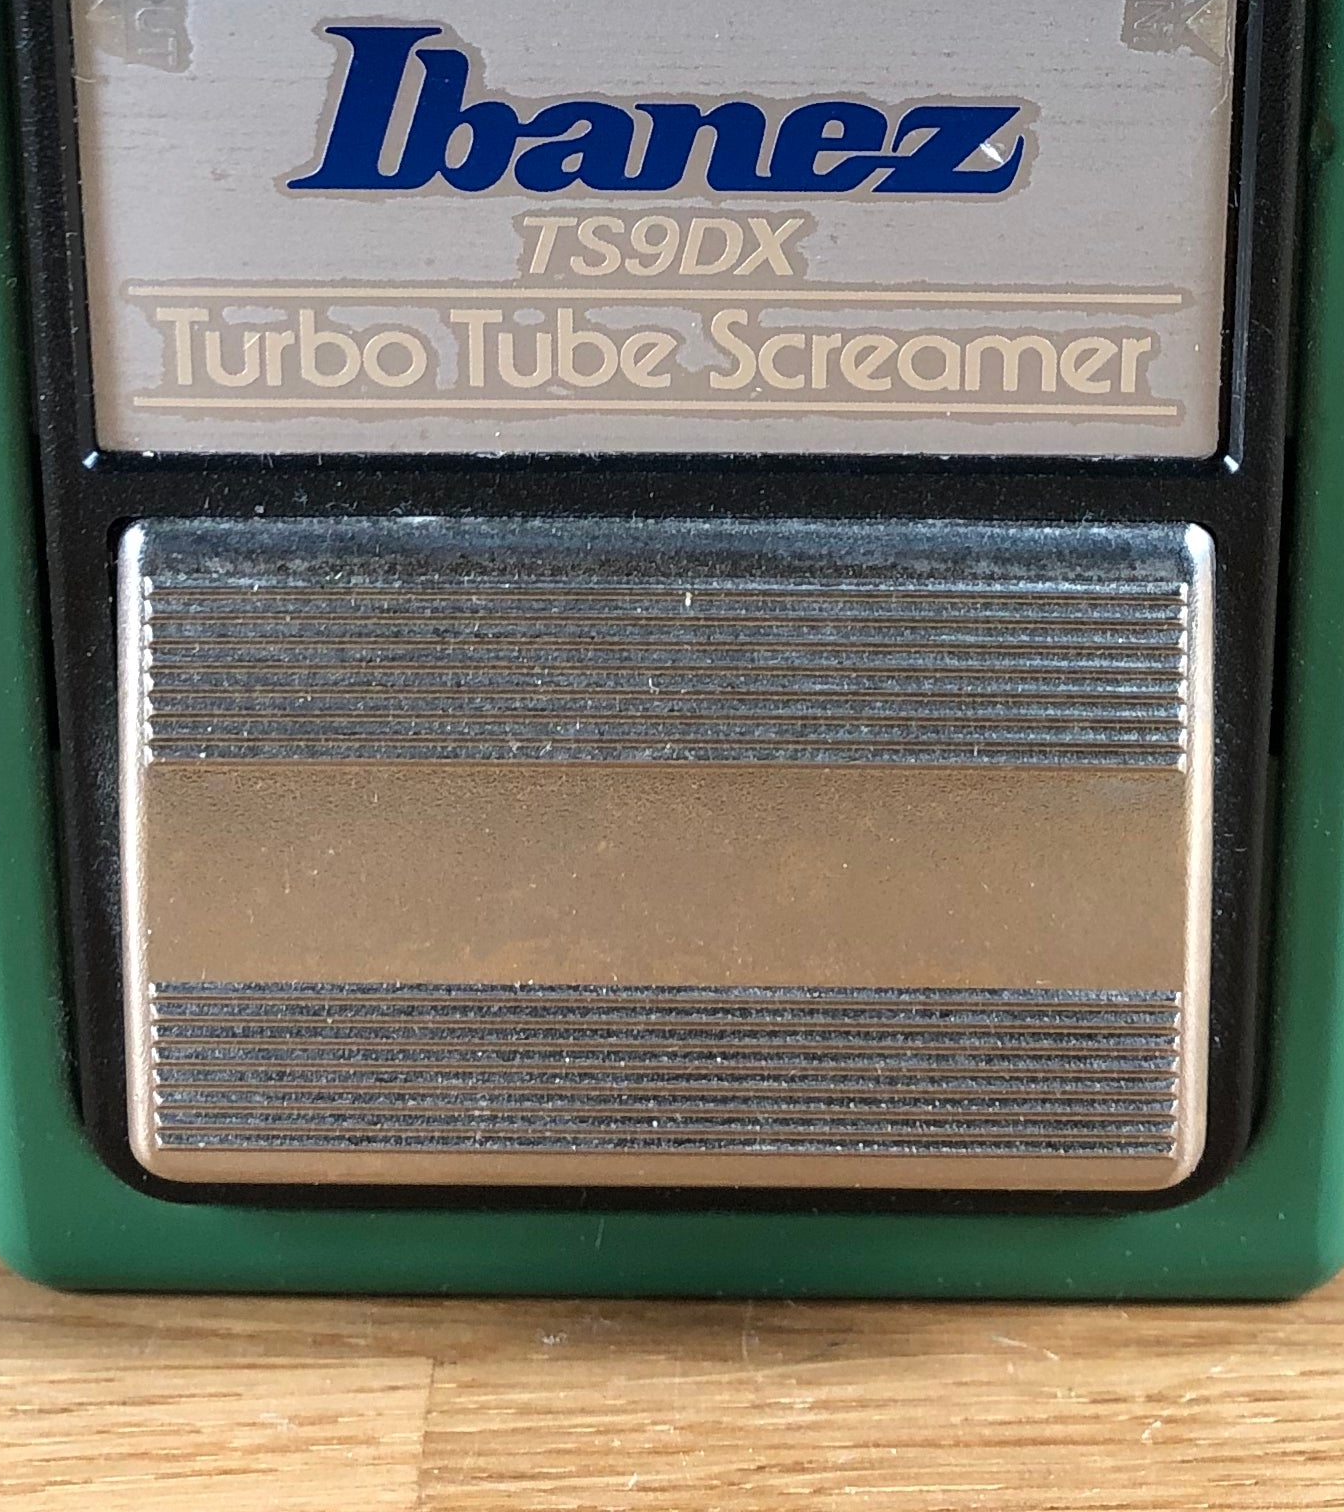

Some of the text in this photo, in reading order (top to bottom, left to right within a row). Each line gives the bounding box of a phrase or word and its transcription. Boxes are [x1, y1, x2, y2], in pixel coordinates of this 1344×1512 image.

[287, 25, 1026, 194] Ibanez
[522, 214, 806, 278] TS9DX
[157, 305, 1153, 396] Turbo Tube Screamer
